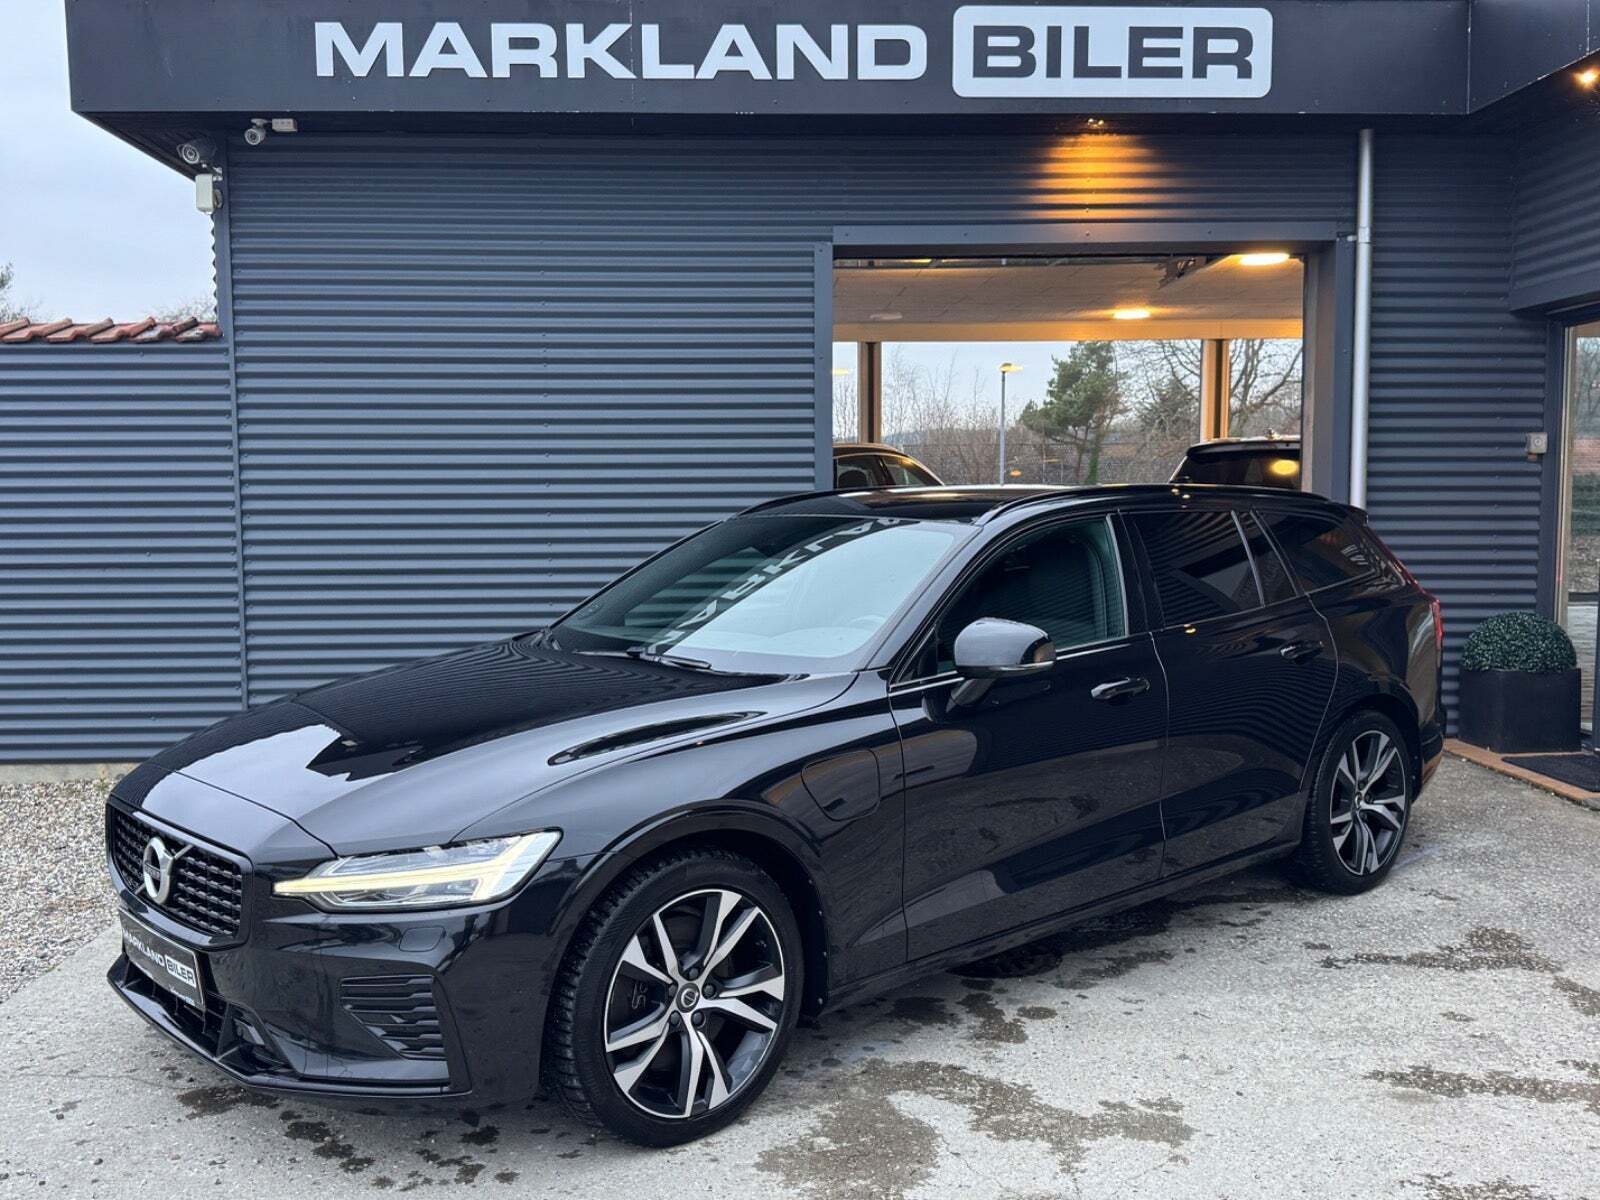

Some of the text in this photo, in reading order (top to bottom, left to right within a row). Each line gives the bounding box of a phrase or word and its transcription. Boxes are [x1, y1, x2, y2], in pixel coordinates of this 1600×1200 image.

[314, 21, 1254, 80] MARKLAND BILER
[122, 927, 196, 987] MARKLAND BILER
